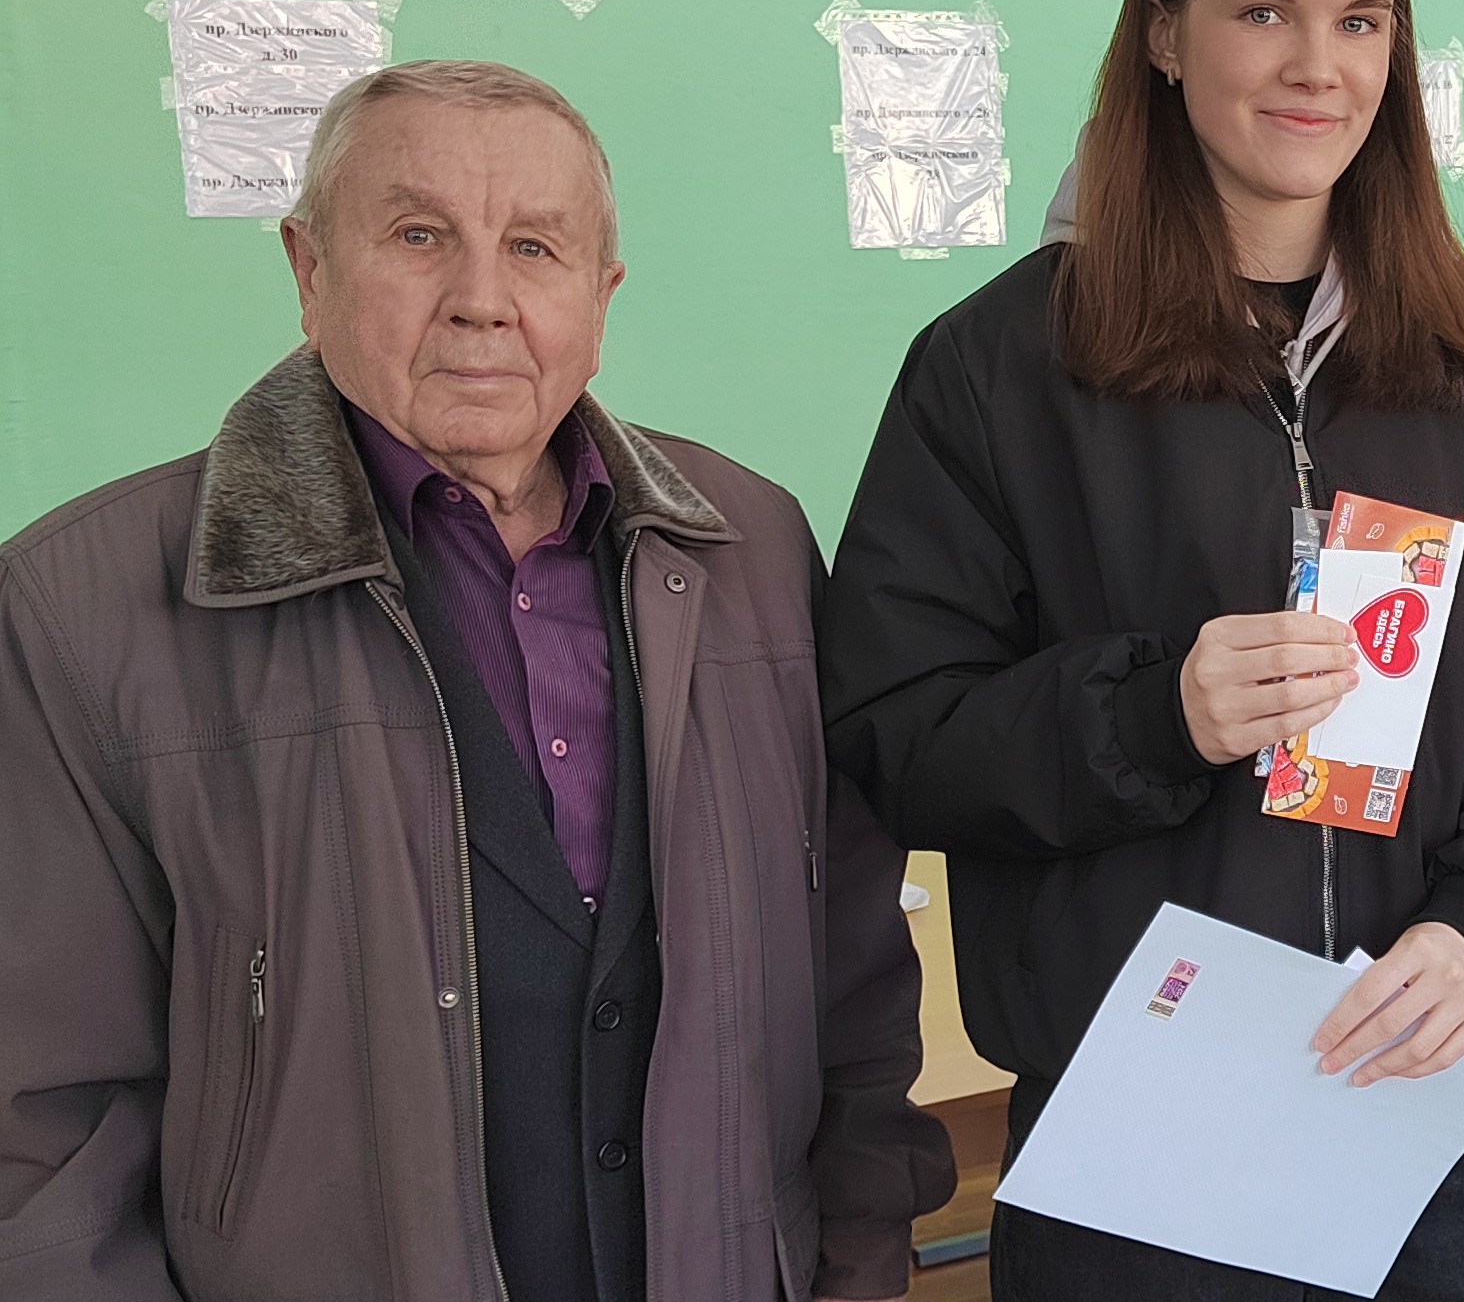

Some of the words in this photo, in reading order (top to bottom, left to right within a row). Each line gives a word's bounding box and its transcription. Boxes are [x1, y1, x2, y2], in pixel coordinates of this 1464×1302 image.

[205, 24, 230, 38] пр.
[280, 48, 298, 61] 30
[1372, 609, 1390, 649] ЗДЕСЬ
[1381, 599, 1406, 664] БРАГИНО
